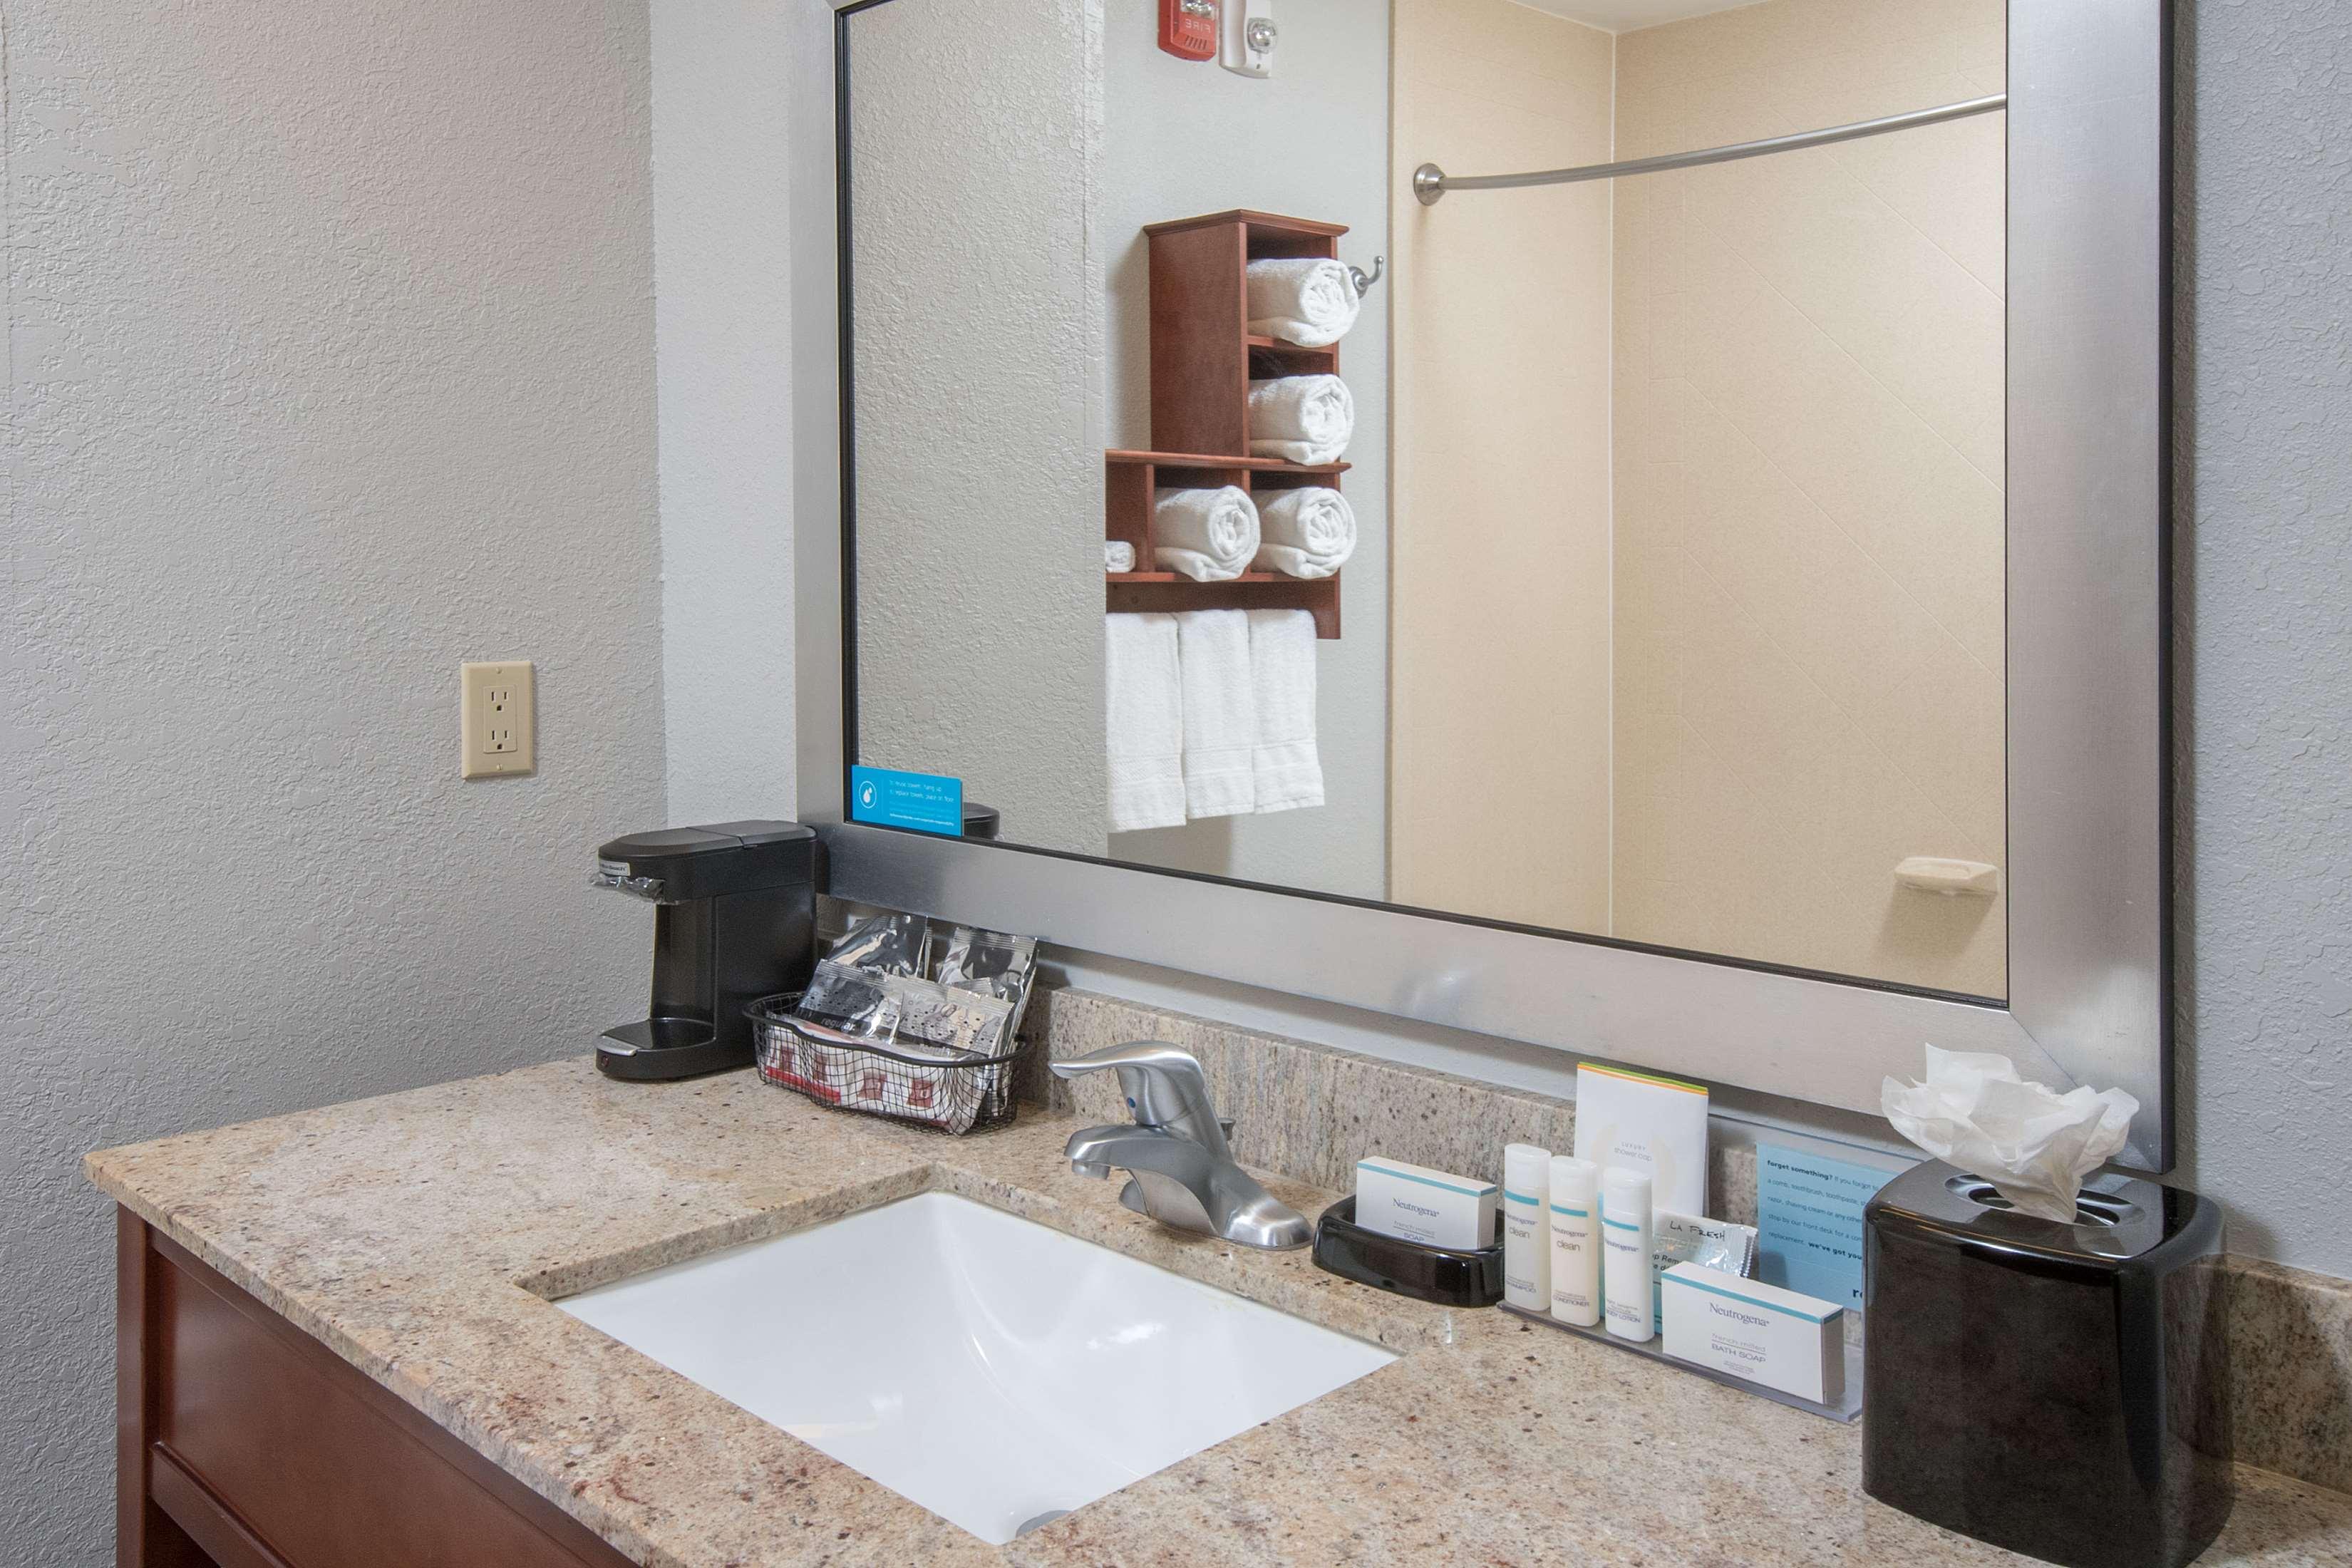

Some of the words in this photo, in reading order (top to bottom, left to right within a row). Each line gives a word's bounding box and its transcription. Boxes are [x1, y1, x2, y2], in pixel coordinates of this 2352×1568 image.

[1768, 1160, 1789, 1170] forget
[1791, 1167, 1833, 1181] something?
[1509, 1226, 1530, 1239] clean
[1689, 1225, 1725, 1242] FRESH
[1557, 1239, 1580, 1252] clean
[1808, 1242, 1830, 1252] we've
[1662, 1254, 1680, 1264] Rem
[1711, 1343, 1737, 1356] BATH
[1739, 1351, 1766, 1363] SOAP
